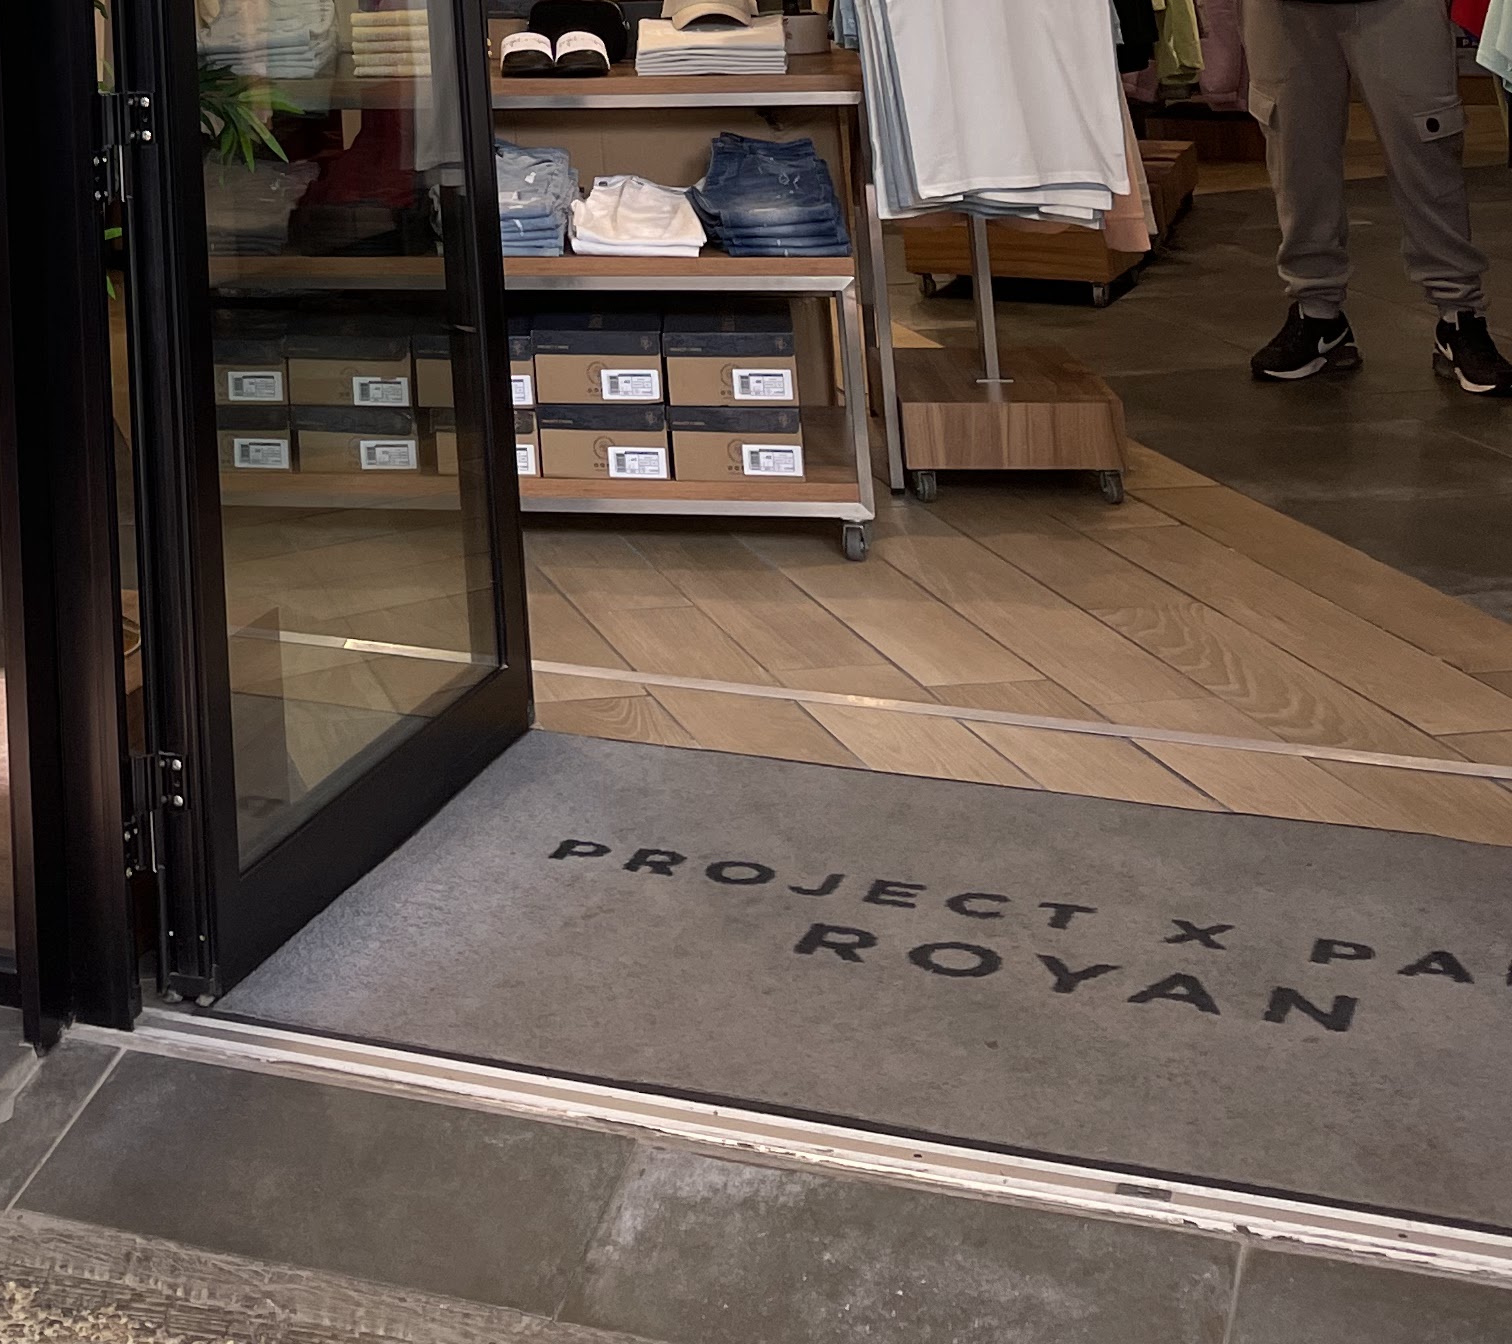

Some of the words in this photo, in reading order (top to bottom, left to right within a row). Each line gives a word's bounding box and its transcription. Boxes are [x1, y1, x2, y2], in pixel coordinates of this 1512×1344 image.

[548, 838, 1099, 932] PROJECT
[1164, 918, 1236, 951] X
[1309, 938, 1512, 987] PA
[793, 922, 1359, 1033] ROYAN
